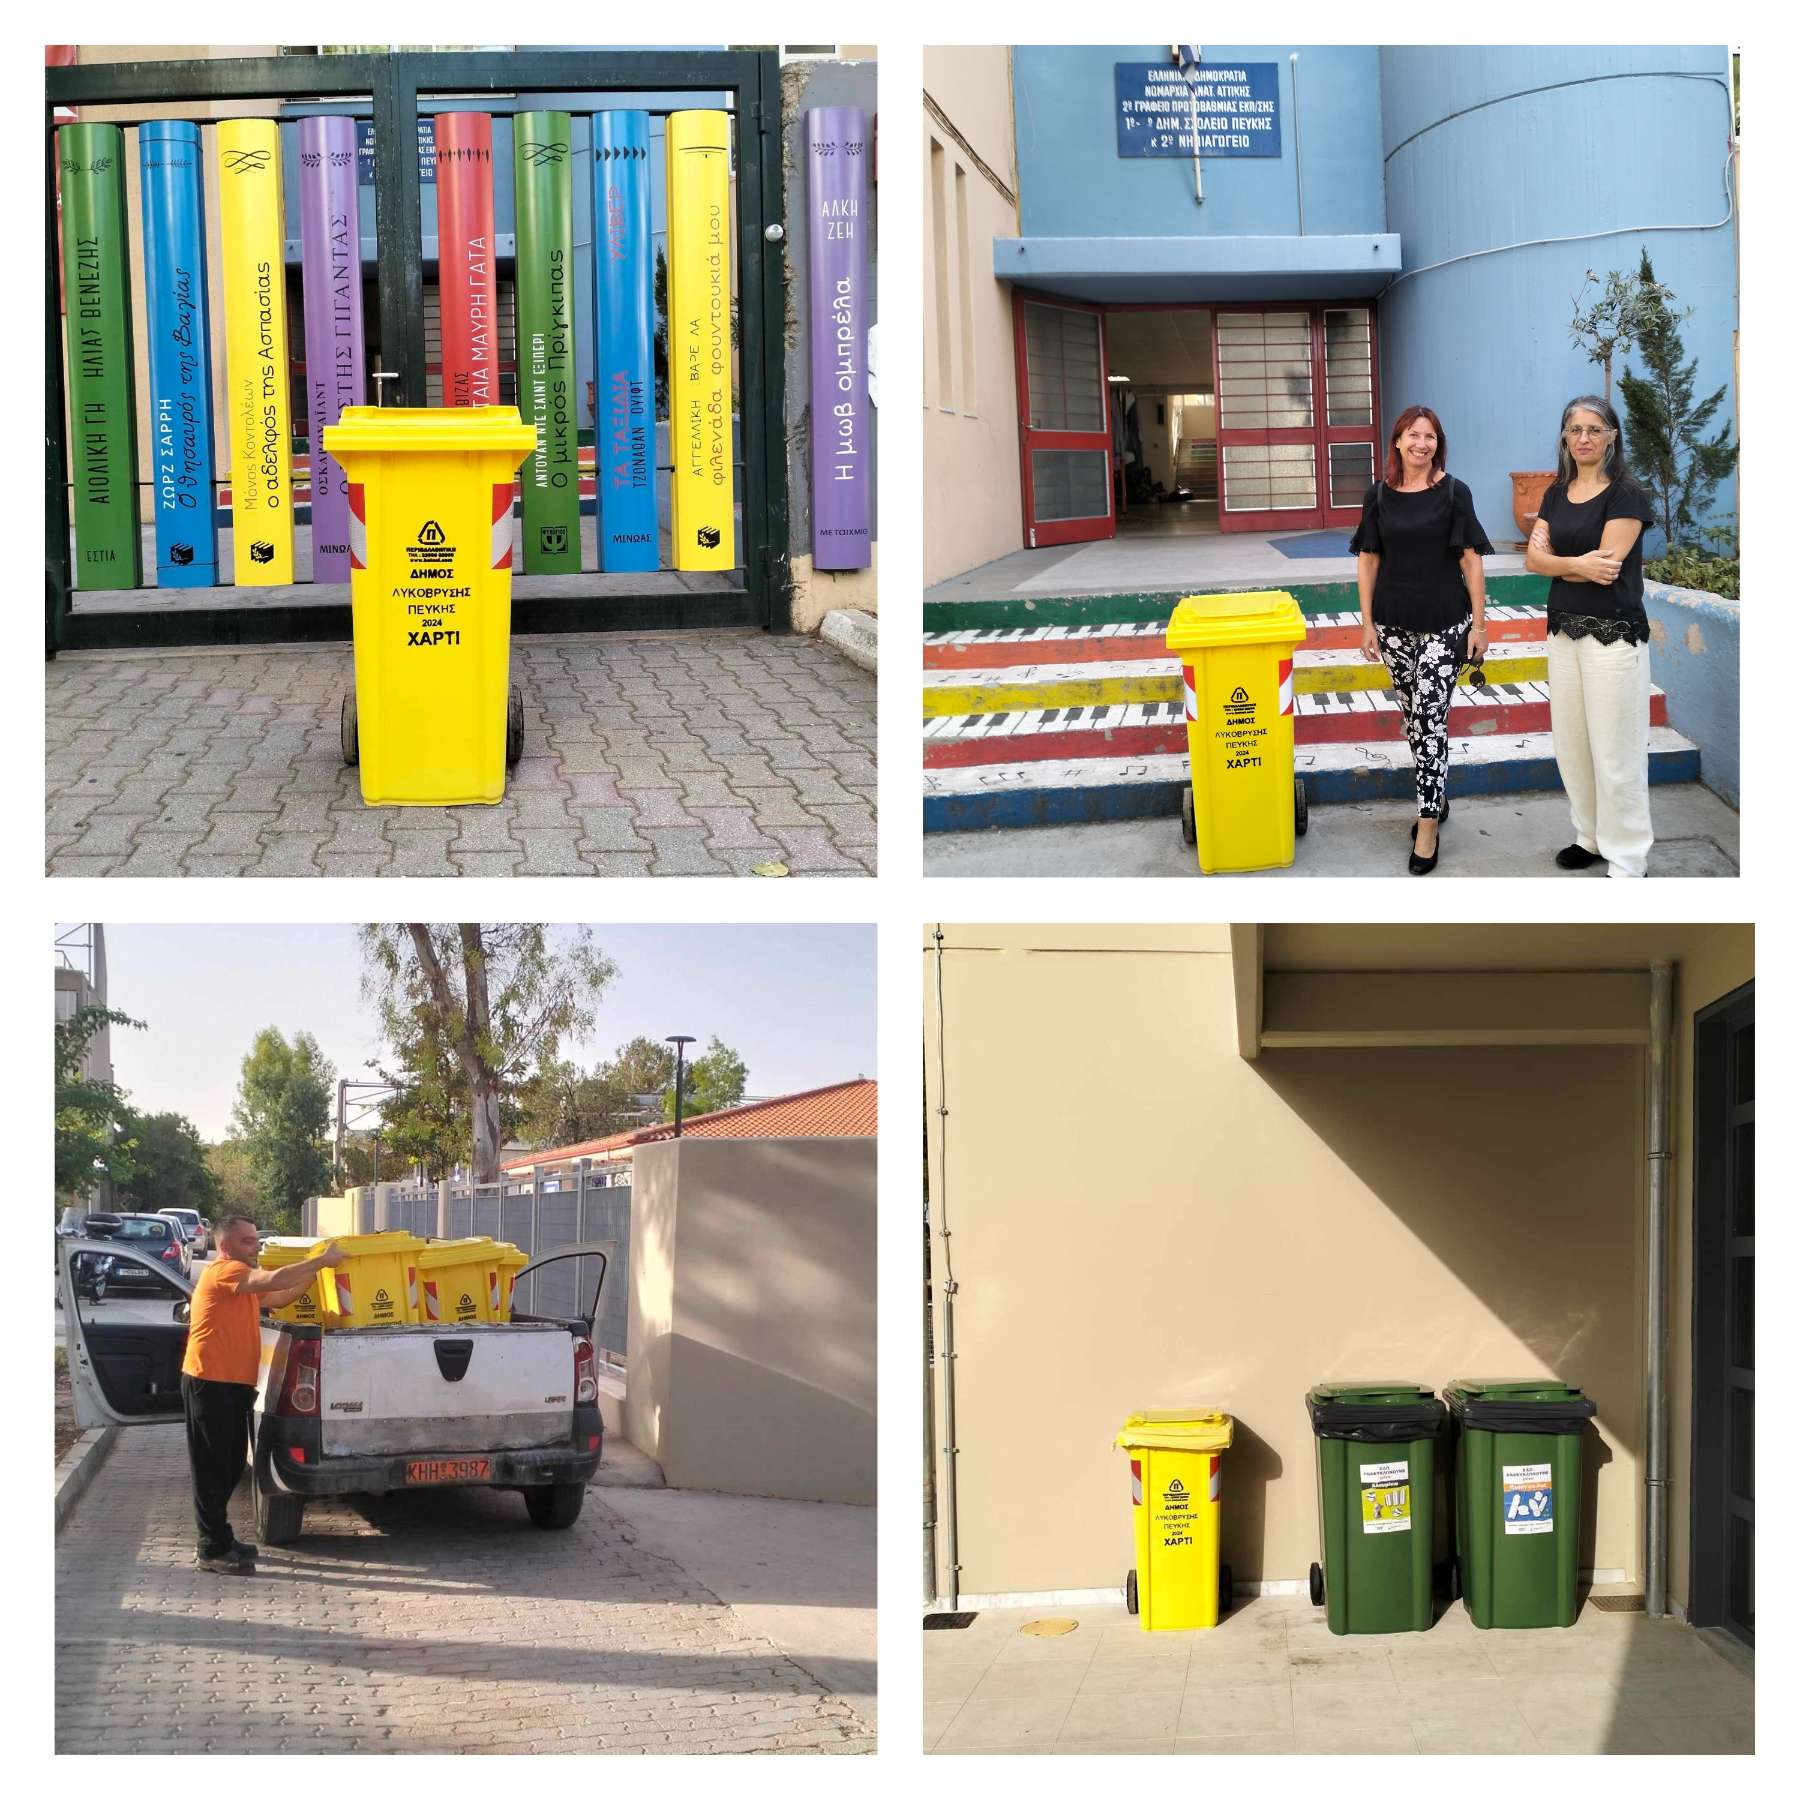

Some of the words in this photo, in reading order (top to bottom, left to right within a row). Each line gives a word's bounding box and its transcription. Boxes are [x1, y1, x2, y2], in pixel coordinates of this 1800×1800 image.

[1148, 70, 1186, 82] ΕΛΛΗΝΙΚ
[1145, 86, 1188, 97] ΝΟΜΑΡΧΙΑ
[1217, 86, 1250, 97] ΑΤΤΙΚΗΣ
[1134, 101, 1170, 112] ΓΡΑΦΕΙΟ
[1232, 117, 1272, 130] ΠΕΥΚΗΣ
[822, 200, 858, 217] ΑΛΚΗ
[708, 204, 724, 244] μου
[828, 223, 853, 239] ΖΕΗ
[469, 237, 487, 286] ΓΑΤΑ
[77, 237, 101, 318] ΒΕΝΕΖΗΣ
[332, 215, 351, 336] ΓΙΓΑΝΤΑΣ
[172, 268, 197, 346] Βαγίας
[254, 262, 275, 359] Ασπασίας
[548, 250, 569, 370] Πρίγκιπας
[706, 252, 722, 375] φουντουκιά
[470, 294, 489, 360] ΜΑΥΡΗ
[832, 277, 856, 391] ομπρέλα
[81, 327, 104, 378] ΗΛΙΑΣ
[532, 333, 546, 374] ΕΞΙΠΕΡΙ
[262, 365, 275, 399] της
[455, 371, 469, 406] ΒΙΖΑΣ
[533, 380, 546, 410] ΣΑΙΝΤ
[85, 403, 106, 424] ΓΗ
[534, 415, 547, 434] ΝΤΕ
[549, 381, 572, 464] μικρός
[160, 399, 173, 456] ΣΑΡΡΗ
[178, 392, 202, 488] θησαυρός
[707, 389, 725, 485] φιλενάδα
[834, 402, 857, 454] μωβ
[260, 405, 281, 489] αδελφός
[632, 427, 647, 488] ΤΖΟΝΑΘΑΝ
[88, 433, 109, 503] ΑΙΟΛΙΚΗ
[535, 439, 548, 488] ΑΝΤΟΥΑΝ
[613, 464, 631, 488] ΤΑ
[834, 466, 854, 480] Η
[160, 464, 176, 509] ΖΩΡΖ
[552, 472, 568, 488] Ο
[320, 544, 351, 553] ΜΙΝΩΑ
[613, 534, 652, 543] ΜΙΝΩΑΣ
[87, 550, 116, 562] ΕΣΤΙΑ
[410, 569, 454, 579] ΔΗΜΟΣ
[392, 587, 471, 598] ΛΥΚΟΒΡΥΣΗΣ
[408, 604, 455, 615] ΠΕΥΚΗΣ
[422, 619, 442, 627] 2024
[408, 631, 460, 646] ΧΑΡΤΙ
[1215, 728, 1268, 738] ΛΥΚΟΒΡΥΣΗΣ
[1226, 718, 1255, 726] ΔΗΜΟΣ
[1226, 740, 1258, 749] ΠΕΥΚΗΣ
[1226, 757, 1262, 769] ΧΑΡΤΙ
[448, 1460, 489, 1479] 3987
[1164, 1537, 1192, 1546] ΧΑΡΤΙ
